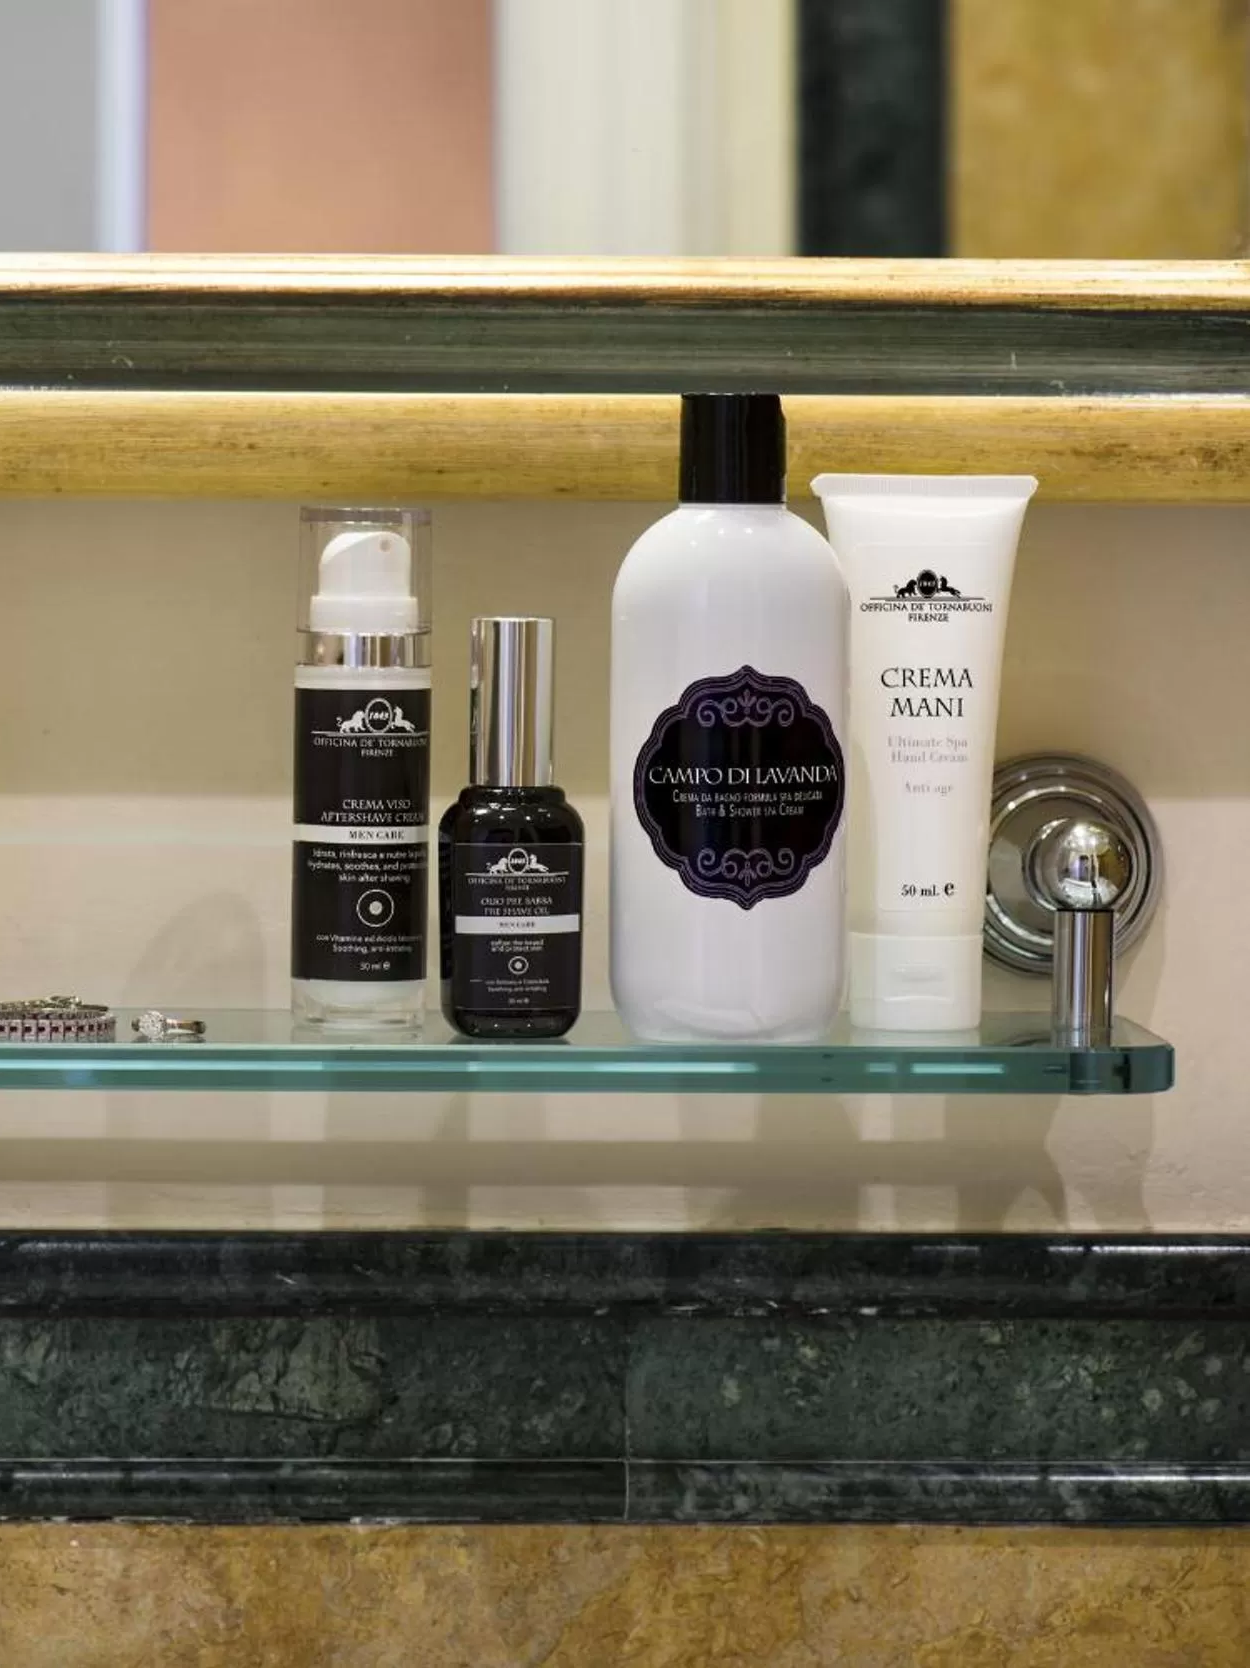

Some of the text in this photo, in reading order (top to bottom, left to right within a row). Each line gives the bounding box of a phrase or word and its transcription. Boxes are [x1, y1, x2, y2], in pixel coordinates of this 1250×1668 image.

[859, 602, 908, 613] OFFICINA
[929, 602, 993, 613] TORNABUONI
[907, 613, 949, 622] FIRENZE
[880, 666, 973, 689] CREMA
[890, 697, 964, 717] MANI
[313, 737, 358, 748] OFFICINA
[887, 735, 967, 751] Ultimate Spa
[891, 751, 968, 763] Hand Cream
[649, 766, 838, 785] CAMPO DI LAVANDA
[342, 799, 411, 810] CREMA VISO
[718, 804, 726, 817] &
[320, 811, 393, 823] AFTERSHAVE
[349, 830, 405, 840] MEN CARE
[900, 884, 916, 897] 50
